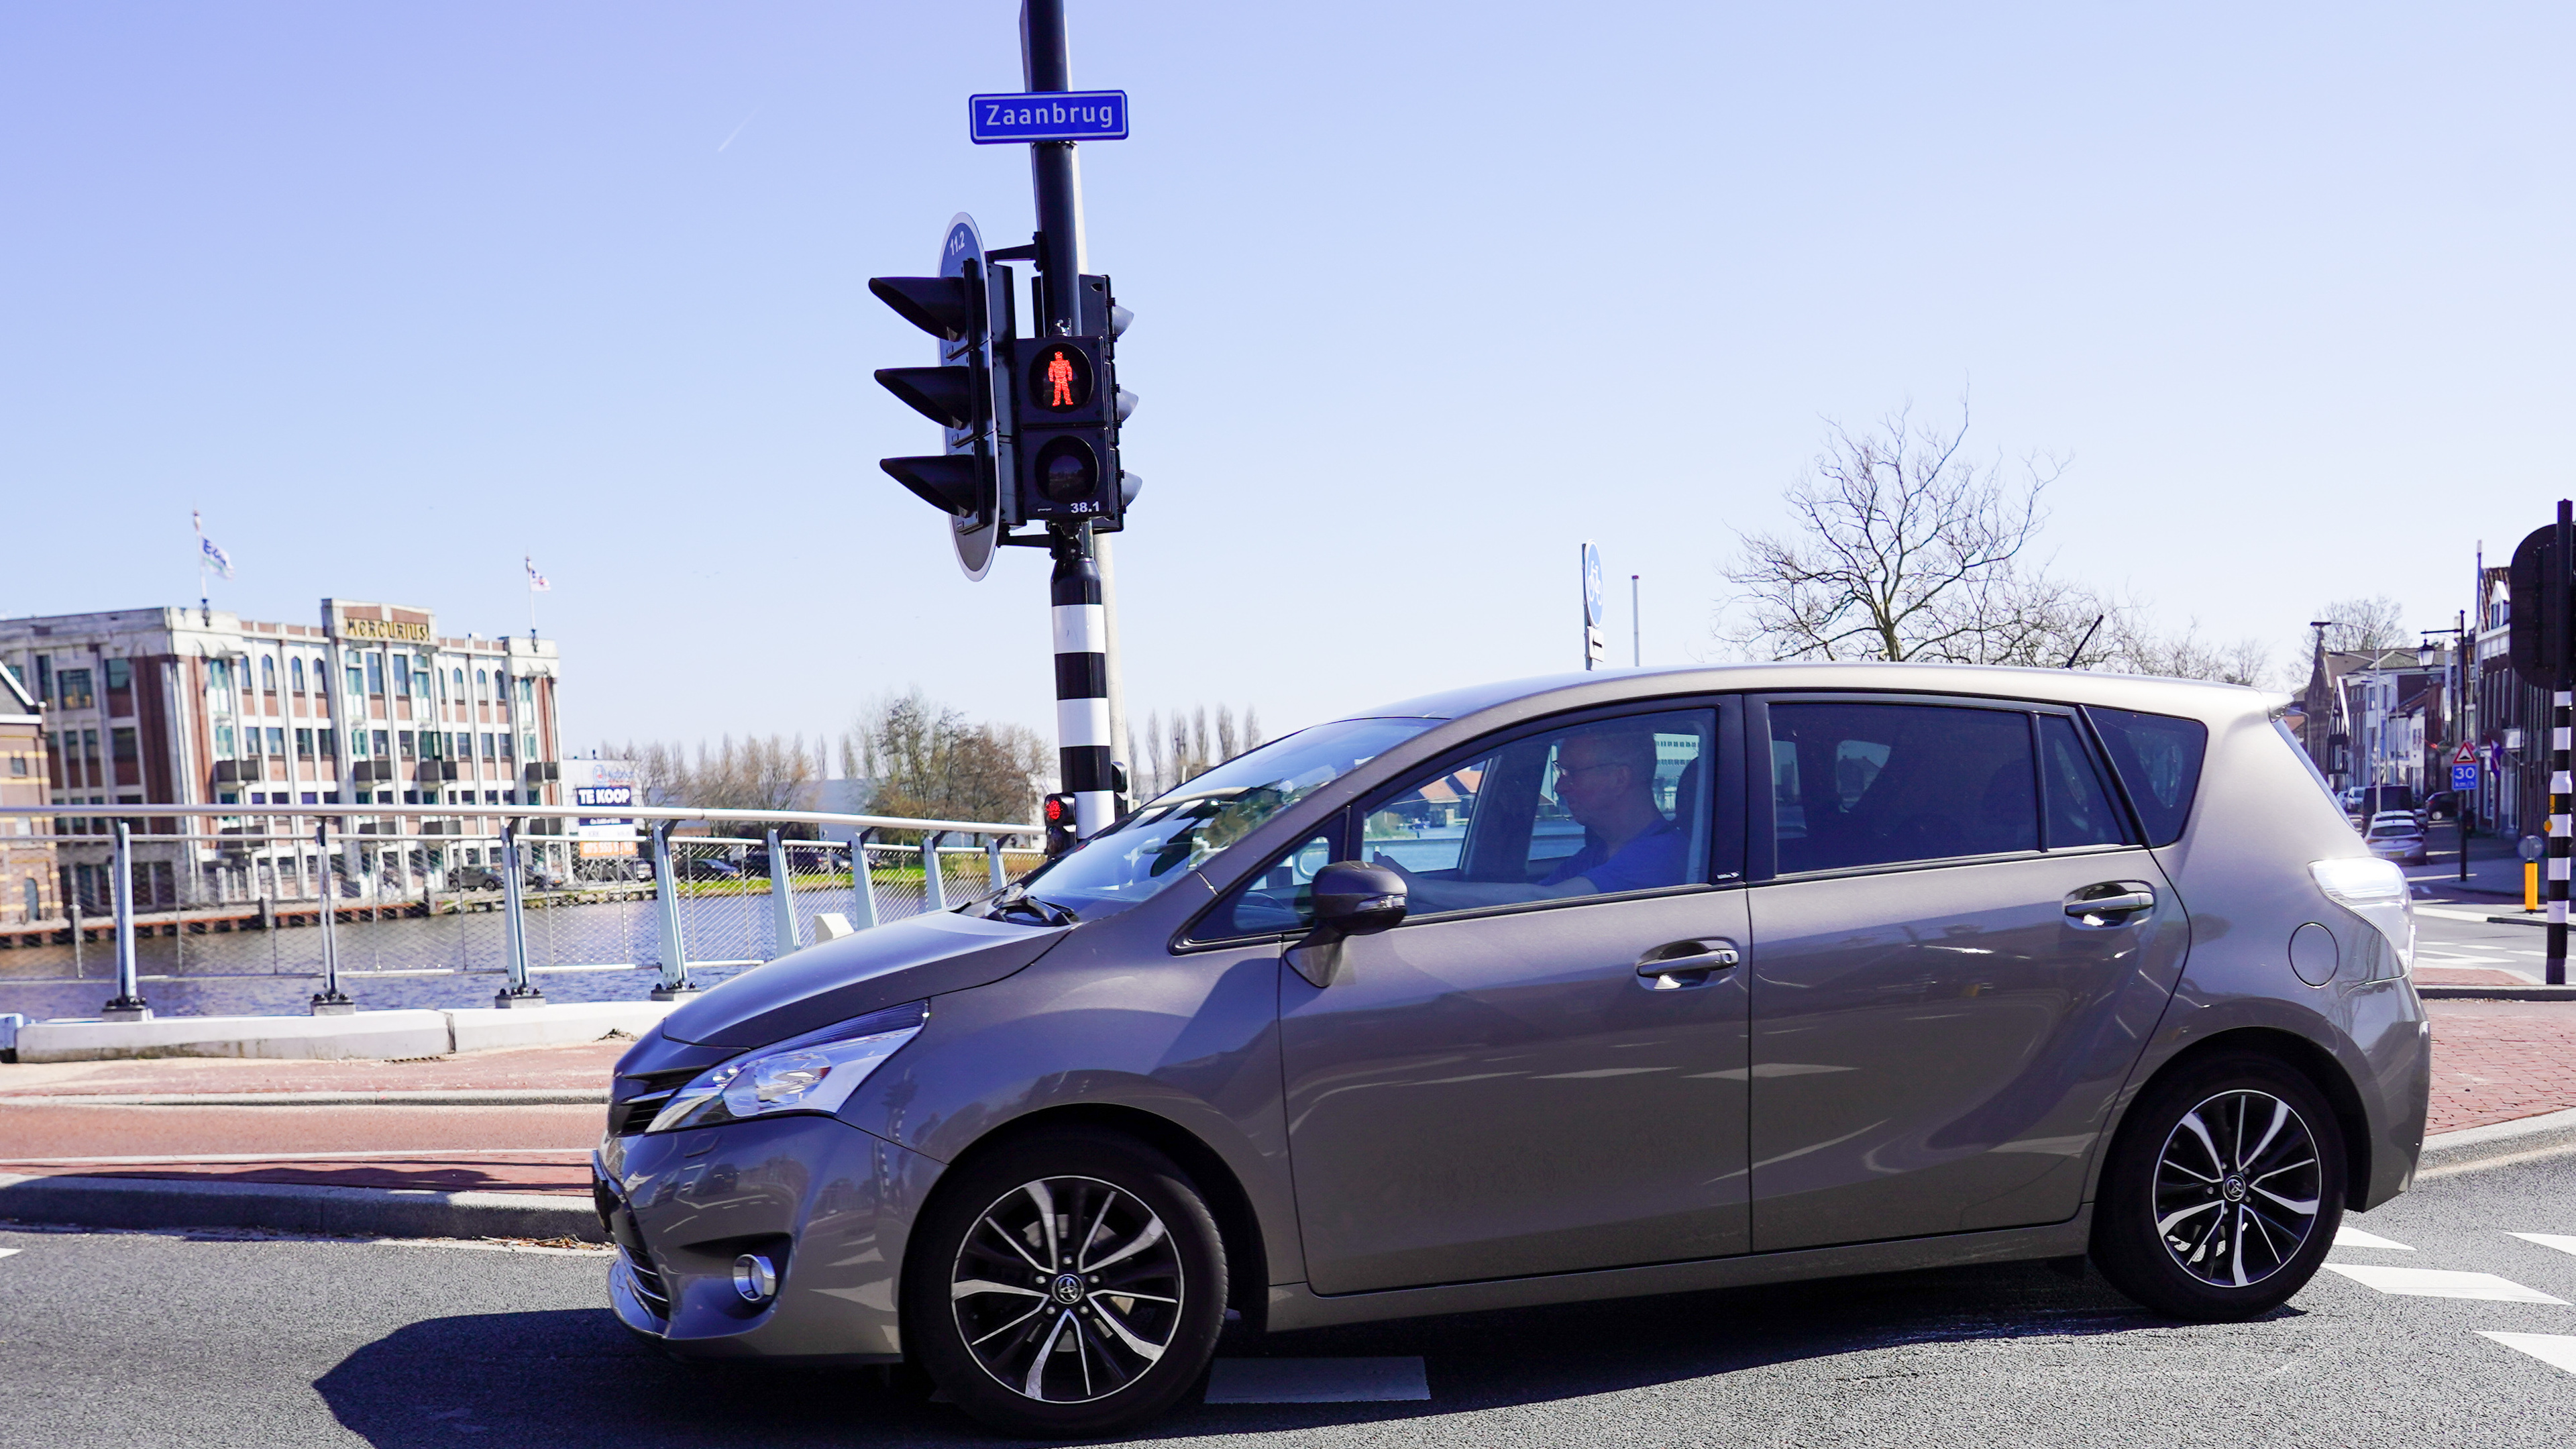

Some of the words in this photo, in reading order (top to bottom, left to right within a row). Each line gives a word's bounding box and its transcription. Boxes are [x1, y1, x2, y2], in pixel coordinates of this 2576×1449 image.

[985, 103, 1113, 128] Zaanbrug
[950, 231, 965, 256] 11.2
[1070, 501, 1099, 513] 38.1
[2455, 767, 2475, 780] 30
[578, 789, 595, 804] TE
[596, 788, 630, 804] KOOP
